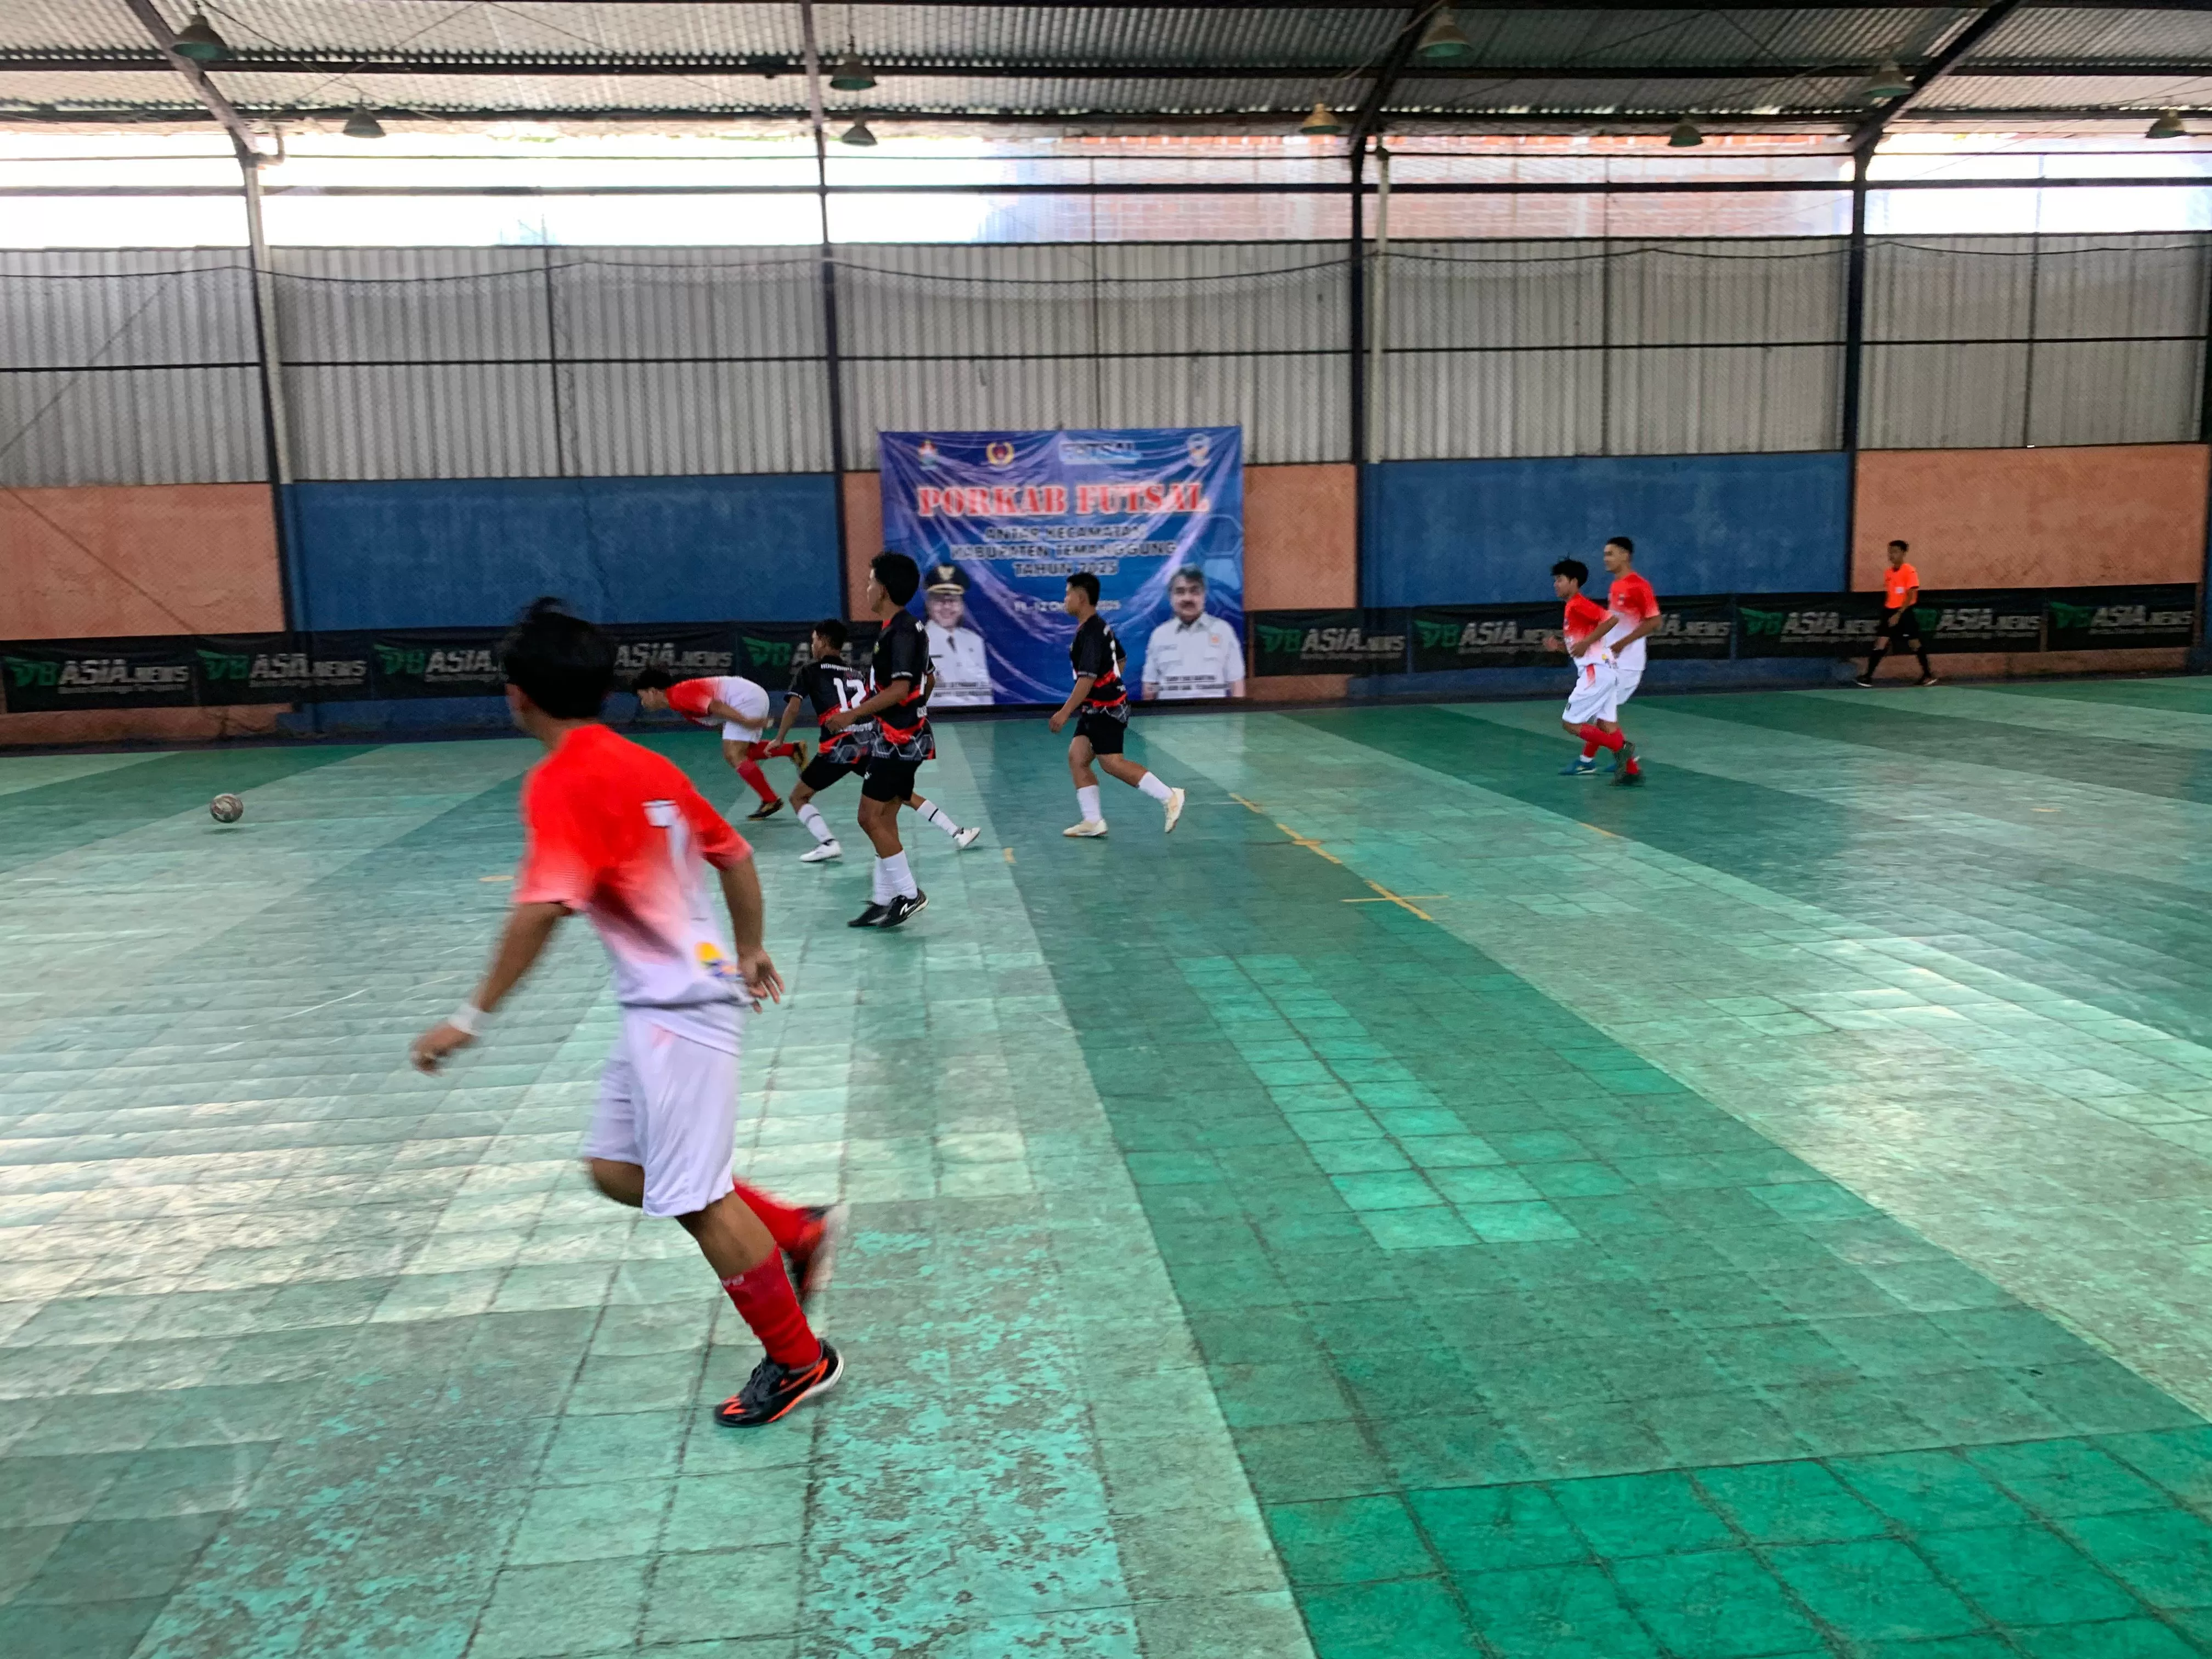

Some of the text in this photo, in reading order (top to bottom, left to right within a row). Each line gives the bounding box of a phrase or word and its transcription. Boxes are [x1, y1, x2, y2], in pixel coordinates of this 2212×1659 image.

[918, 483, 1210, 516] PORKAB FUTSAL
[1015, 562, 1073, 575] TAHUN
[833, 677, 867, 713] 12
